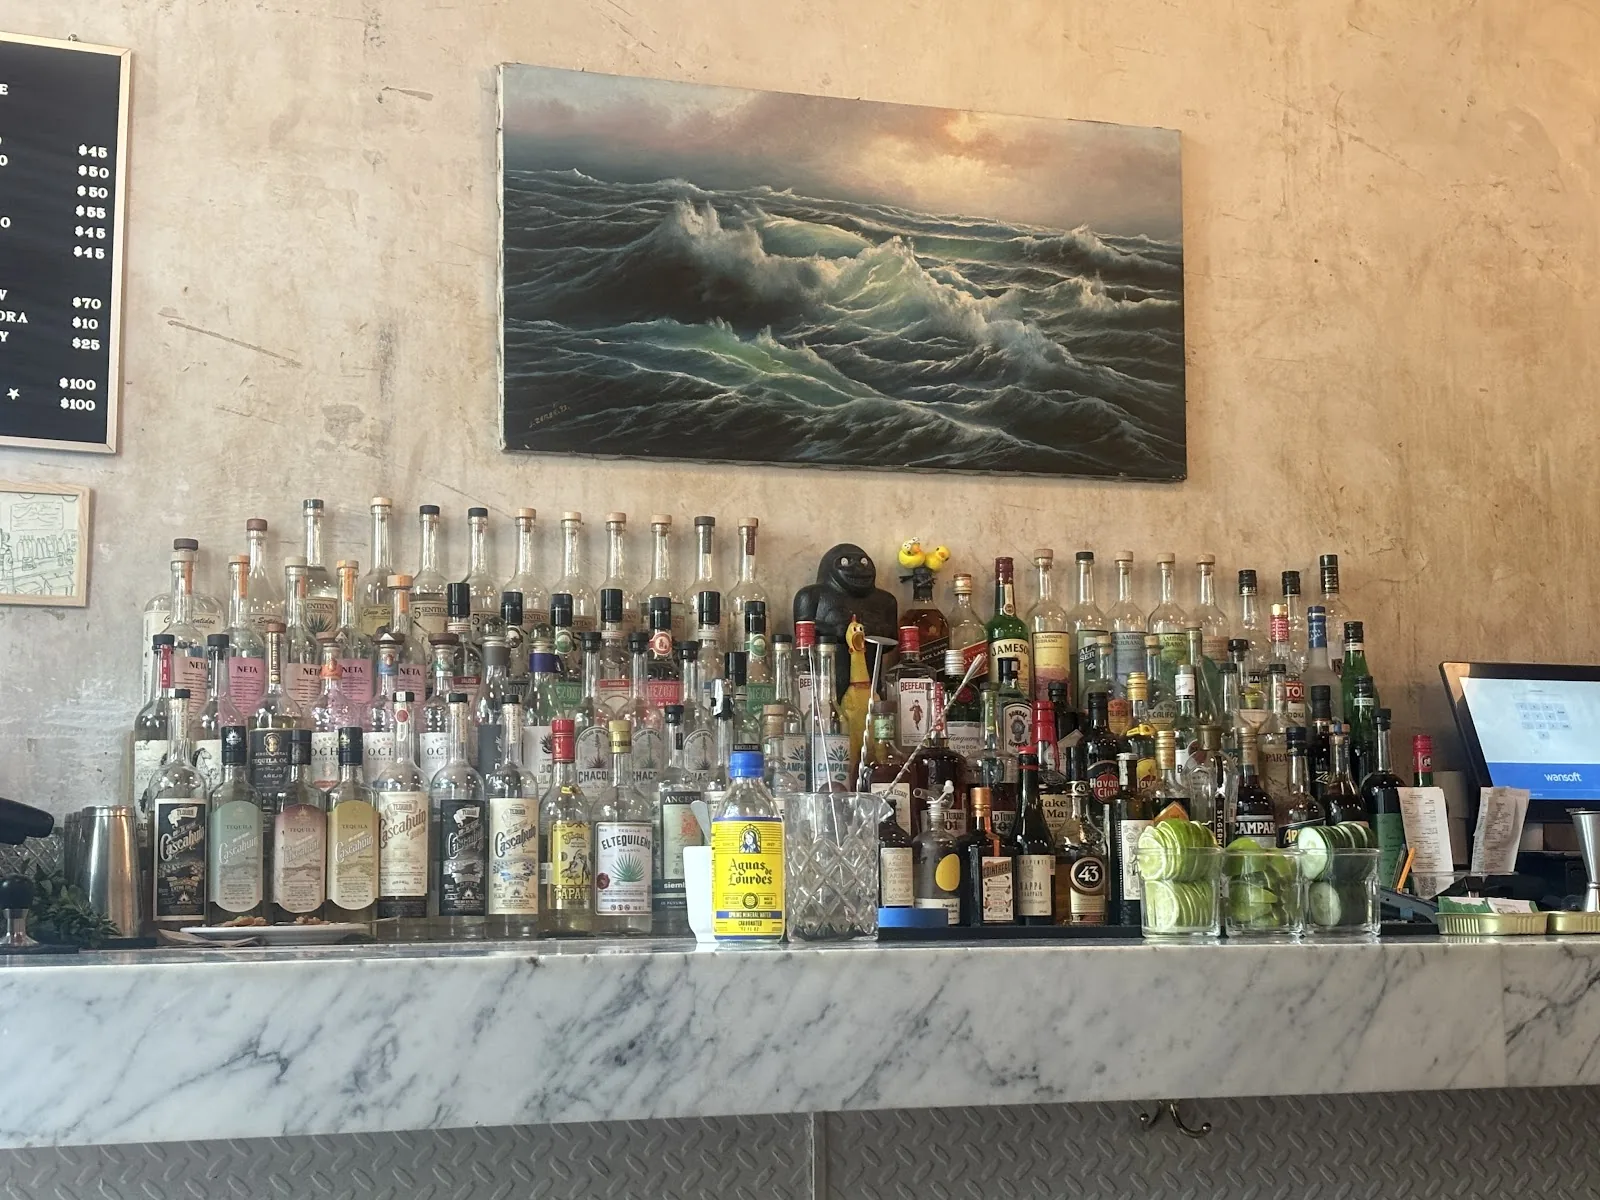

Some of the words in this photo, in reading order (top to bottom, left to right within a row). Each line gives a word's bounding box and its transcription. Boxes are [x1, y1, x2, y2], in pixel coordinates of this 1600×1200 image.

[79, 144, 107, 158] $45
[78, 165, 109, 178] $50
[77, 185, 108, 198] $50
[76, 205, 106, 219] $55
[75, 226, 105, 239] $45
[74, 246, 105, 259] $45
[73, 297, 101, 309] $70
[72, 317, 98, 329] $10
[72, 337, 100, 350] $25
[59, 378, 96, 390] $100
[60, 397, 95, 411] $100
[413, 607, 421, 619] 5
[991, 643, 1029, 657] JAMESO
[188, 660, 207, 669] NETA
[236, 664, 258, 674] NETA
[399, 667, 421, 676] NETA
[900, 681, 926, 692] BEEFEAT
[311, 747, 339, 758] OCH
[1265, 753, 1288, 763] PARA
[1089, 777, 1119, 789] Havan
[1544, 771, 1582, 782] wansoft
[1234, 821, 1276, 836] CAMPAR
[728, 858, 767, 877] Aguas
[1077, 865, 1100, 882] 43
[728, 873, 773, 886] Lourdes
